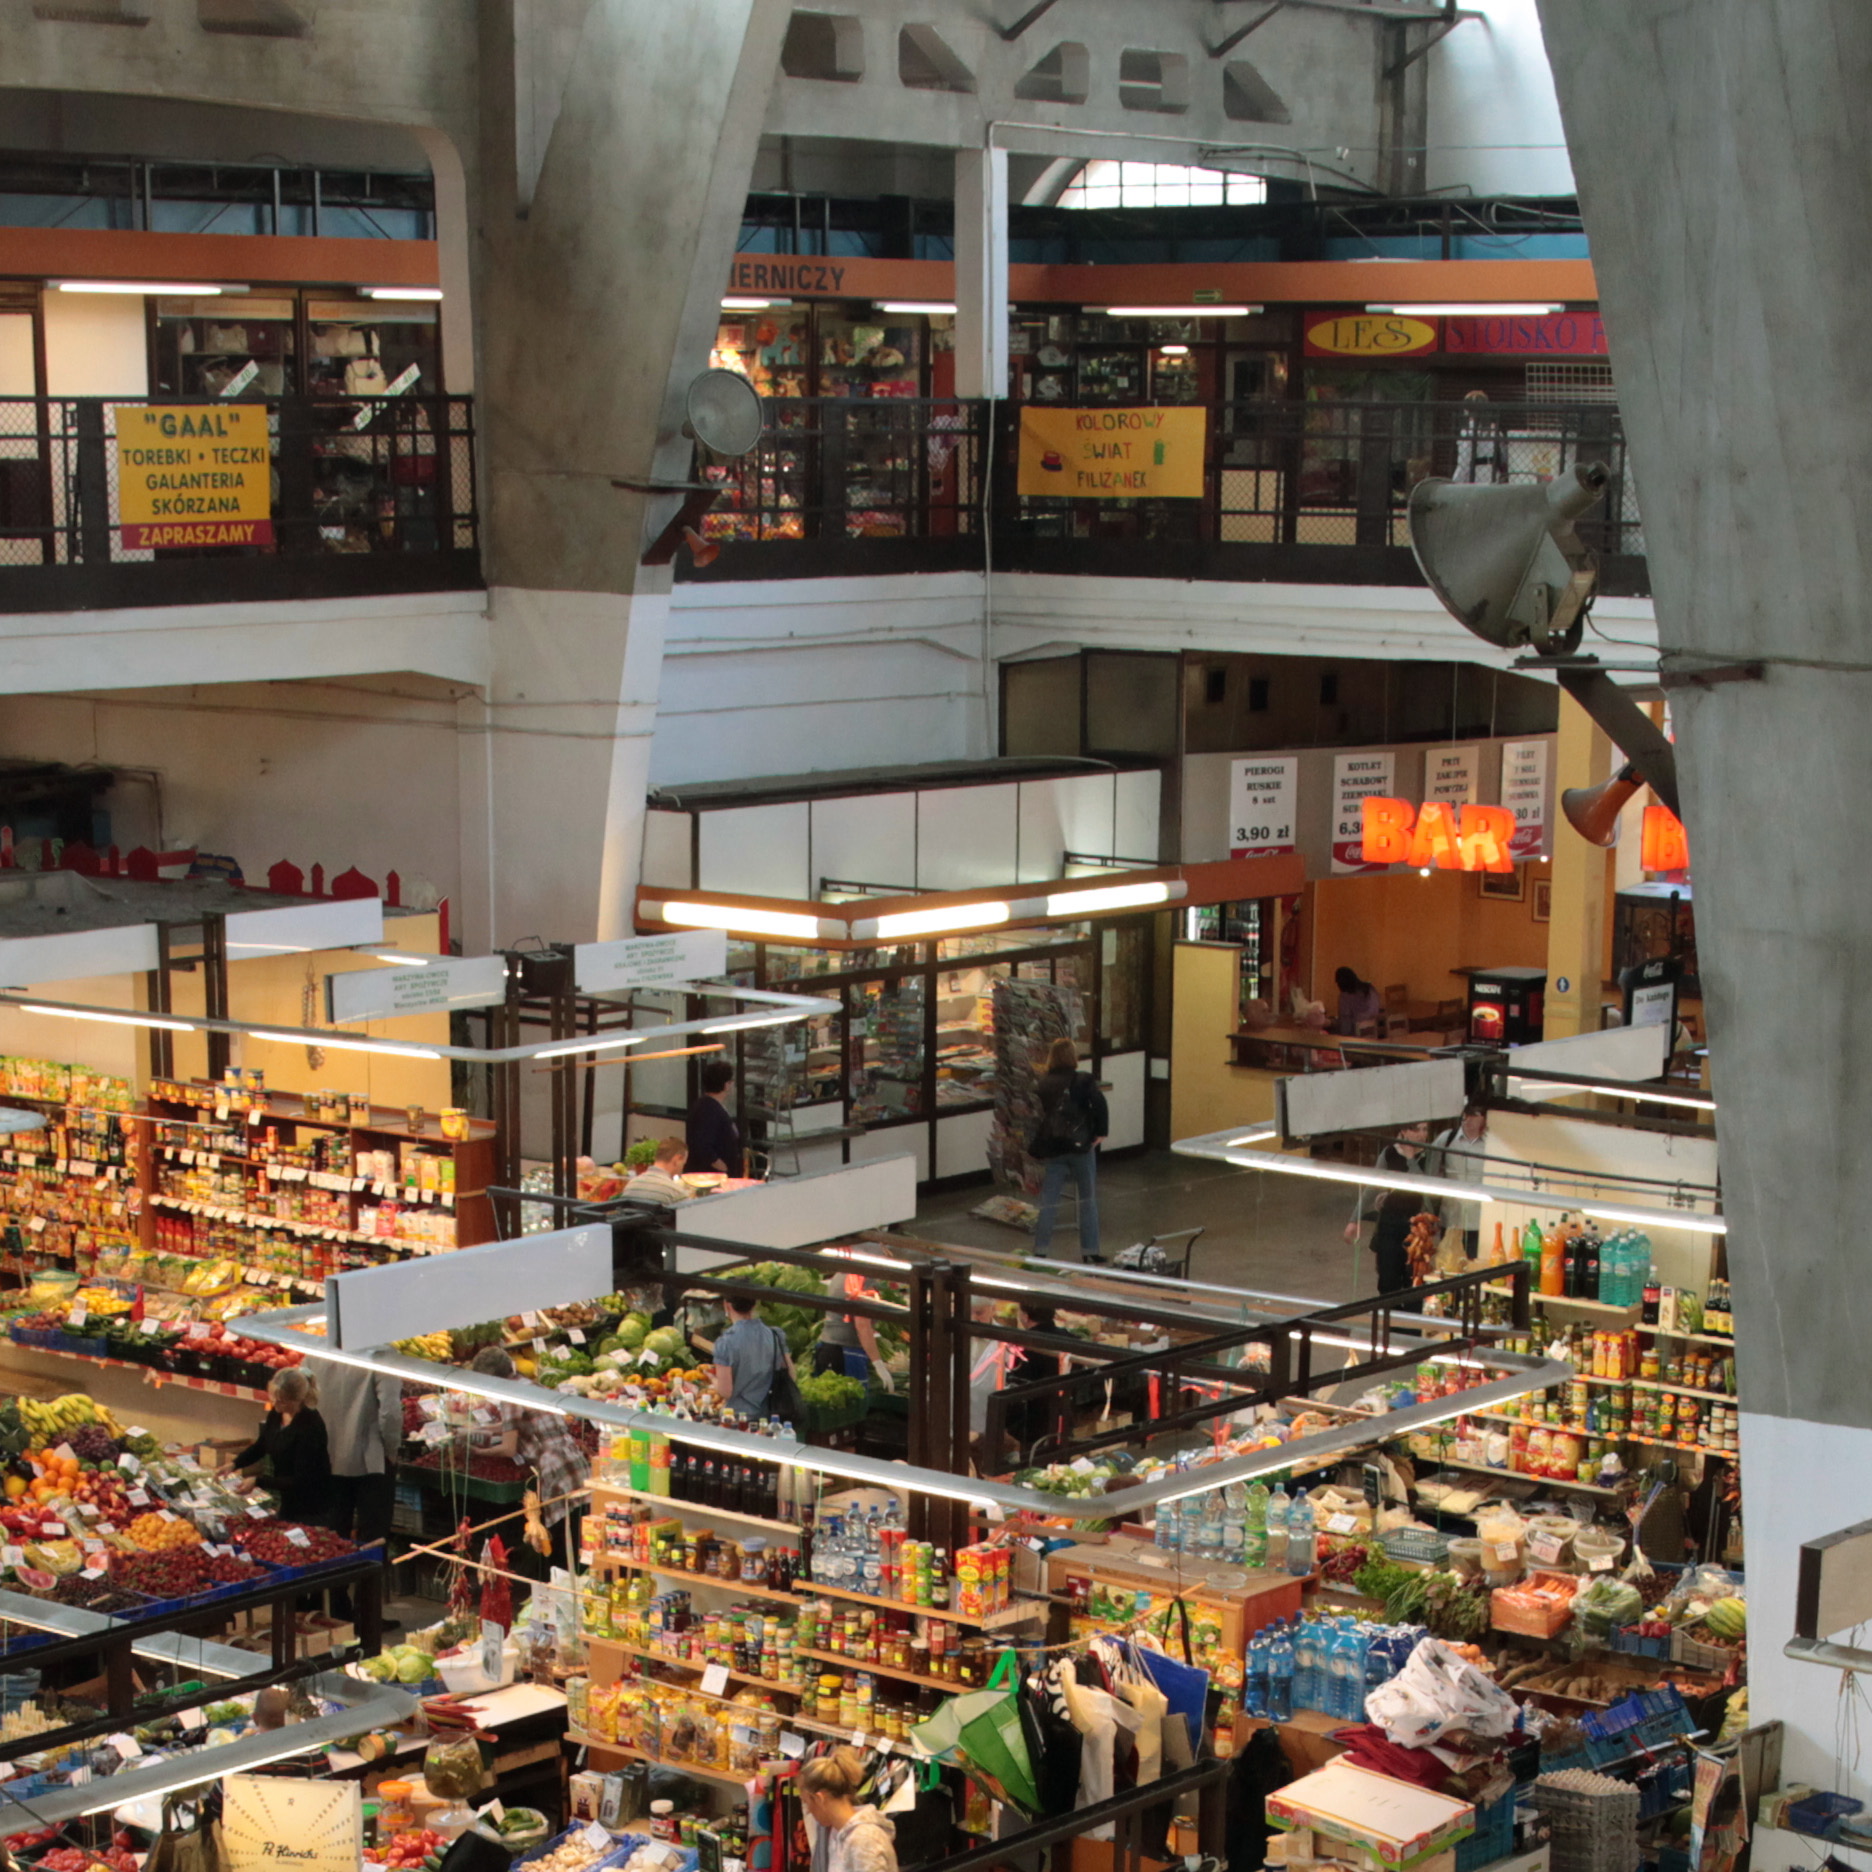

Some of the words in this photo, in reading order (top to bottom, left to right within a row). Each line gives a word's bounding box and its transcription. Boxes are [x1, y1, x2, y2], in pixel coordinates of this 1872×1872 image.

[1332, 318, 1413, 349] LES
[1445, 316, 1578, 349] STOISKO
[1075, 412, 1165, 431] KOLOROWY
[123, 449, 191, 467] TOREBKI
[212, 447, 266, 464] TECZKI
[1083, 440, 1132, 461] ŚWIAT
[146, 472, 245, 491] GALANTERIA
[151, 493, 241, 515] SKÓRZANA
[138, 524, 256, 547] ZAPRASZAMY
[1244, 765, 1285, 776] PIEROGI
[1348, 762, 1381, 772] KOTLET
[1246, 781, 1282, 792] RUSKIE
[1237, 827, 1270, 842] 3,90
[1277, 825, 1291, 840] zł
[1362, 796, 1517, 879] BAR
